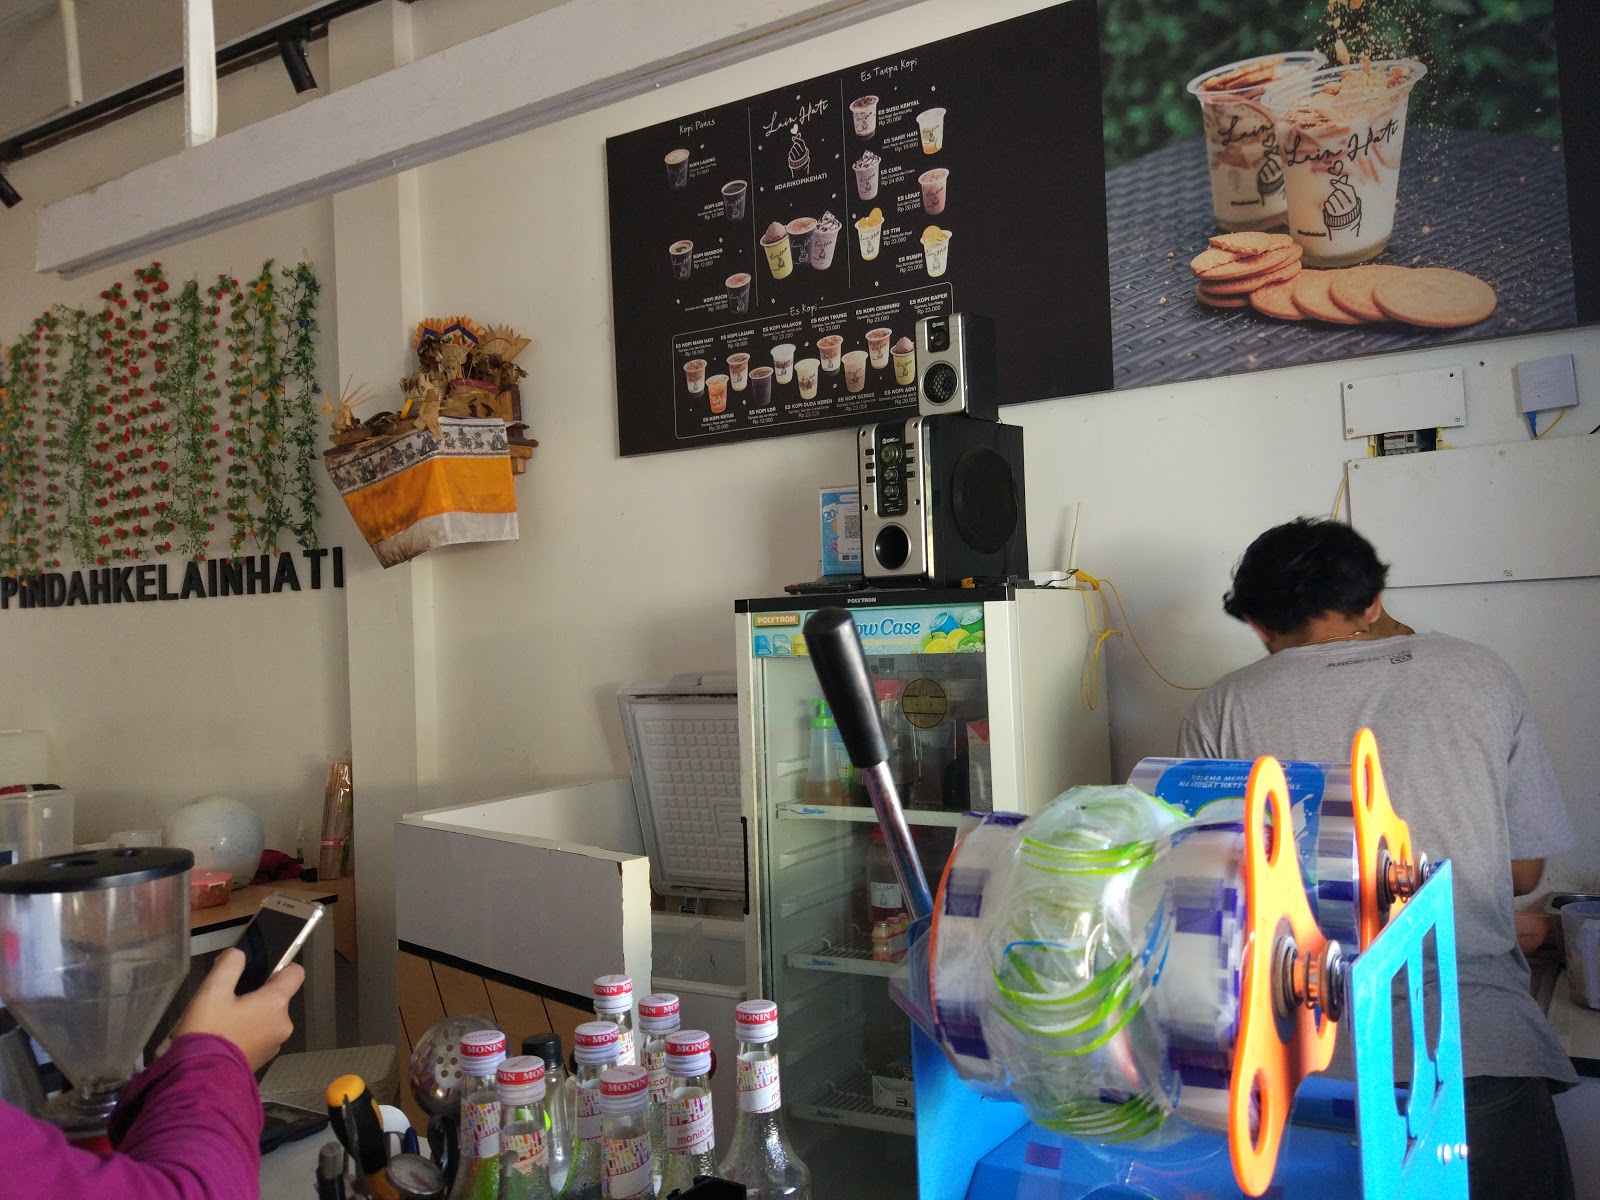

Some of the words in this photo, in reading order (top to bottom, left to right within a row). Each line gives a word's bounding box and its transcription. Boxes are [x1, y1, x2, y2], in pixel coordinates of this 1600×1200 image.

[861, 71, 872, 82] Es
[873, 64, 899, 78] Tanpa
[900, 57, 918, 72] Kopi
[886, 105, 900, 113] SUSU
[900, 99, 920, 110] KENYAL
[763, 111, 798, 137] Lain
[798, 98, 829, 126] Hati
[679, 124, 694, 137] Kopi
[695, 119, 716, 130] Panas
[1218, 116, 1274, 146] Lain
[1284, 135, 1342, 167] Lain
[1347, 119, 1399, 162] Hati
[774, 172, 828, 191] #DARIKOPIKEHATI
[930, 293, 948, 301] BAPER
[790, 306, 800, 317] Es
[802, 303, 818, 316] Kopi
[1, 547, 344, 609] PINDAHKELAINHATI
[757, 616, 796, 625] POLYTRON
[856, 623, 879, 636] ow
[880, 618, 920, 637] Case
[595, 985, 618, 994] ONIN
[639, 1006, 656, 1015] NIN
[663, 1002, 680, 1014] MON
[738, 1012, 771, 1023] MONIN
[467, 1042, 503, 1055] MONIN
[676, 1040, 710, 1053] MONIN
[498, 1072, 516, 1083] NIN
[523, 1067, 545, 1081] MON
[608, 1077, 647, 1093] MONIN
[677, 1121, 713, 1144] monin.co
